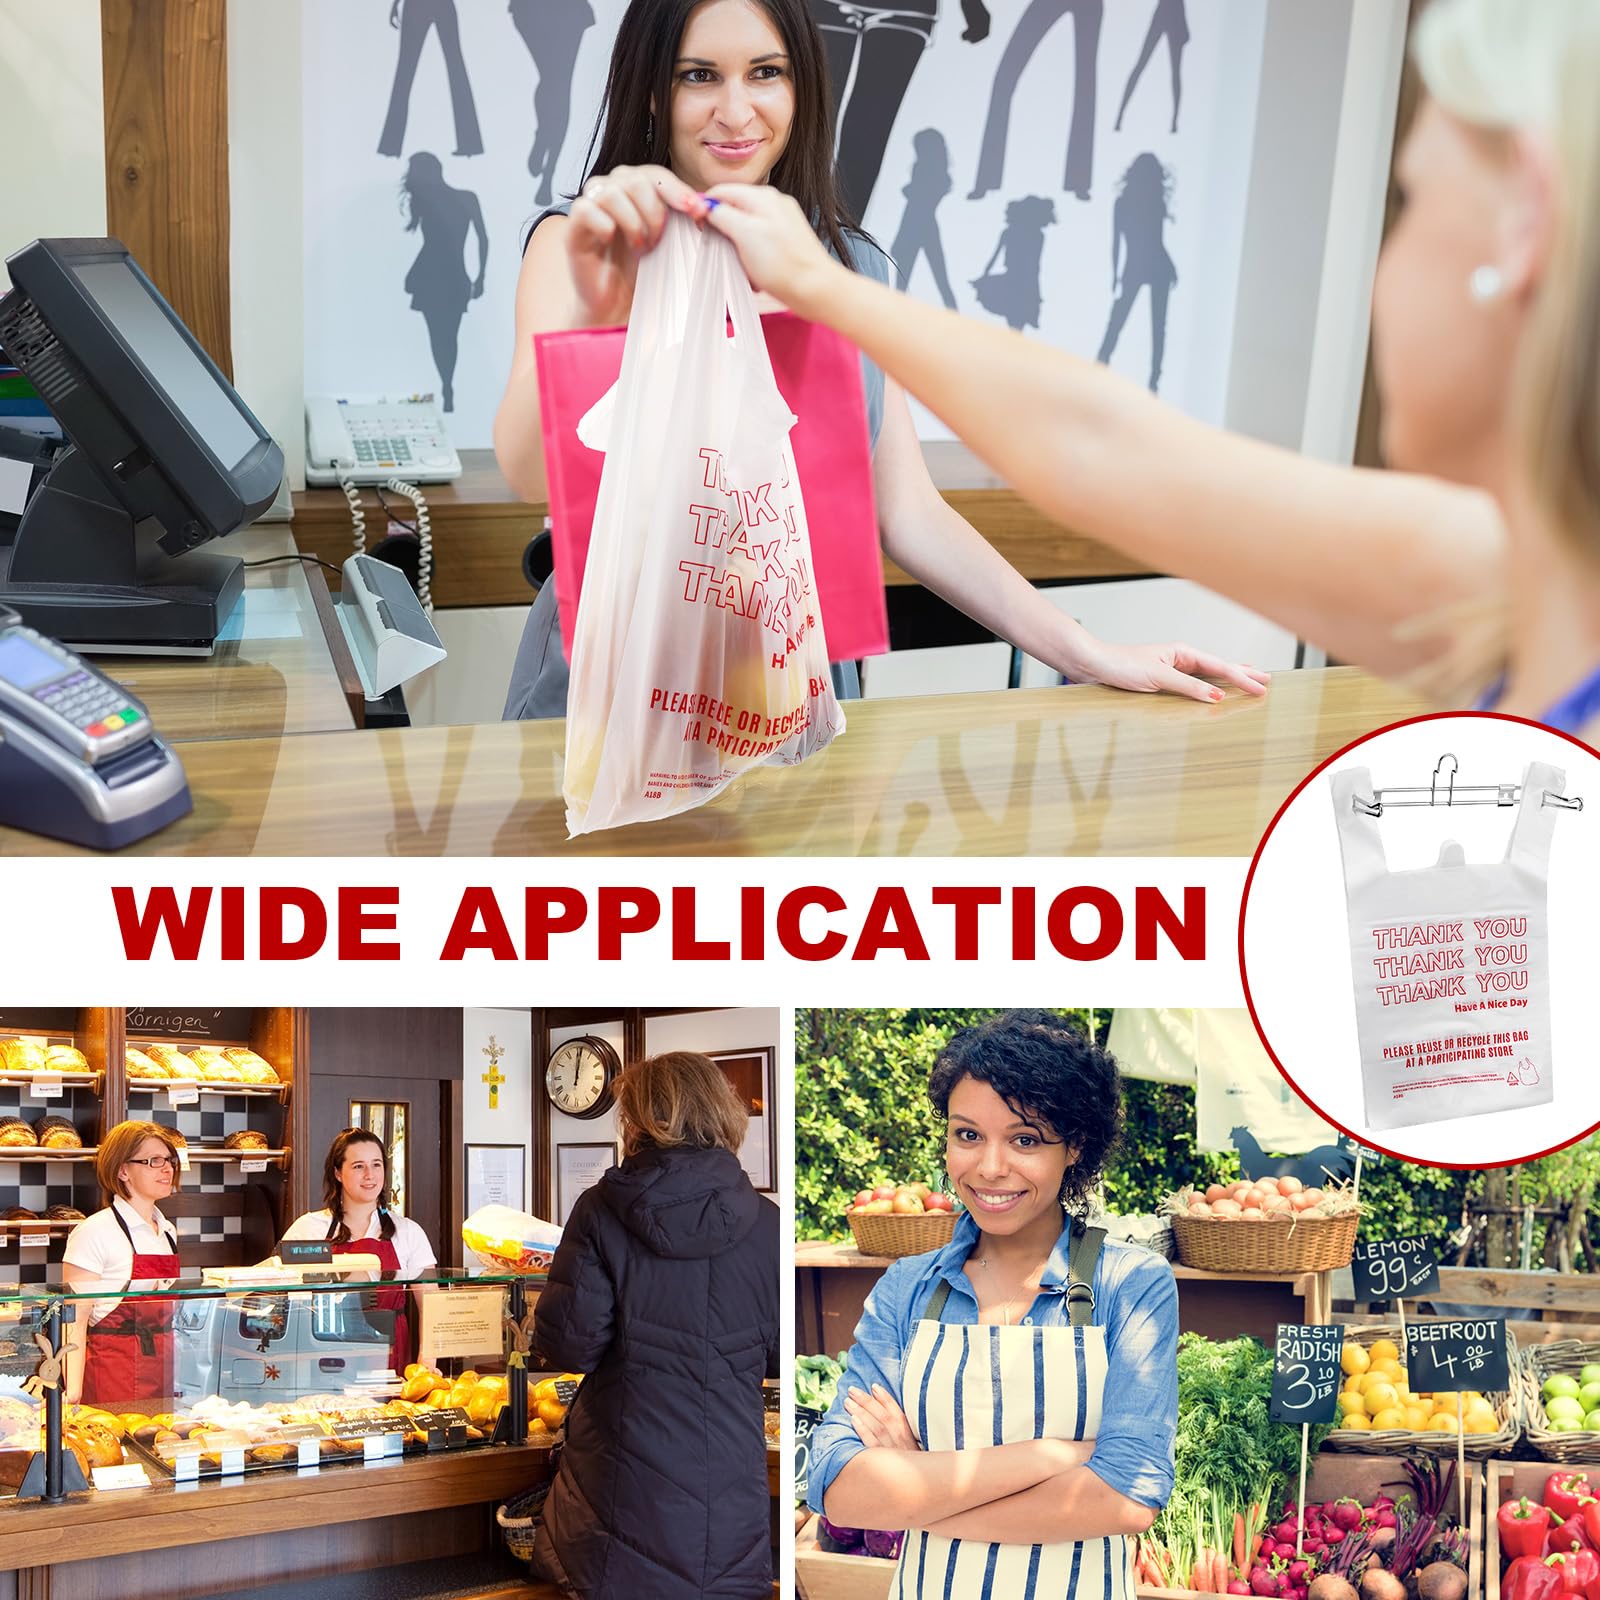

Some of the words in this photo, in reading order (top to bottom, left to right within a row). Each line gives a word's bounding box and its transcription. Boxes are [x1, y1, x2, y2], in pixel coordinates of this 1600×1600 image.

[737, 710, 761, 734] OR
[1373, 923, 1464, 950] THANK
[1474, 917, 1527, 939] YOU
[1373, 949, 1465, 978] THANK
[1475, 944, 1528, 966] YOU
[1376, 975, 1466, 1006] THANK
[1475, 970, 1528, 992] YOU
[1455, 1003, 1477, 1013] Have
[1479, 1001, 1485, 1010] A
[1488, 999, 1507, 1009] Nice
[1510, 998, 1528, 1009] Day
[1383, 1044, 1414, 1059] PLEASE
[1417, 1040, 1442, 1054] REUSE
[1444, 1038, 1454, 1050] OR
[1457, 1034, 1491, 1048] RECYCLE
[1493, 1032, 1511, 1044] THIS
[1512, 1030, 1529, 1042] BAG
[1405, 1057, 1415, 1068] AT
[1418, 1056, 1424, 1066] A
[1426, 1048, 1486, 1066] PARTICIPATING
[1488, 1045, 1514, 1058] STORE
[1368, 1256, 1407, 1295] 99
[1277, 1325, 1338, 1339] FRESH
[1407, 1321, 1497, 1342] BEETROOT
[1277, 1338, 1341, 1363] RADISH
[1465, 1345, 1483, 1357] 00
[1318, 1367, 1334, 1380] 10
[1469, 1358, 1484, 1371] LB
[1318, 1384, 1333, 1400] LB
